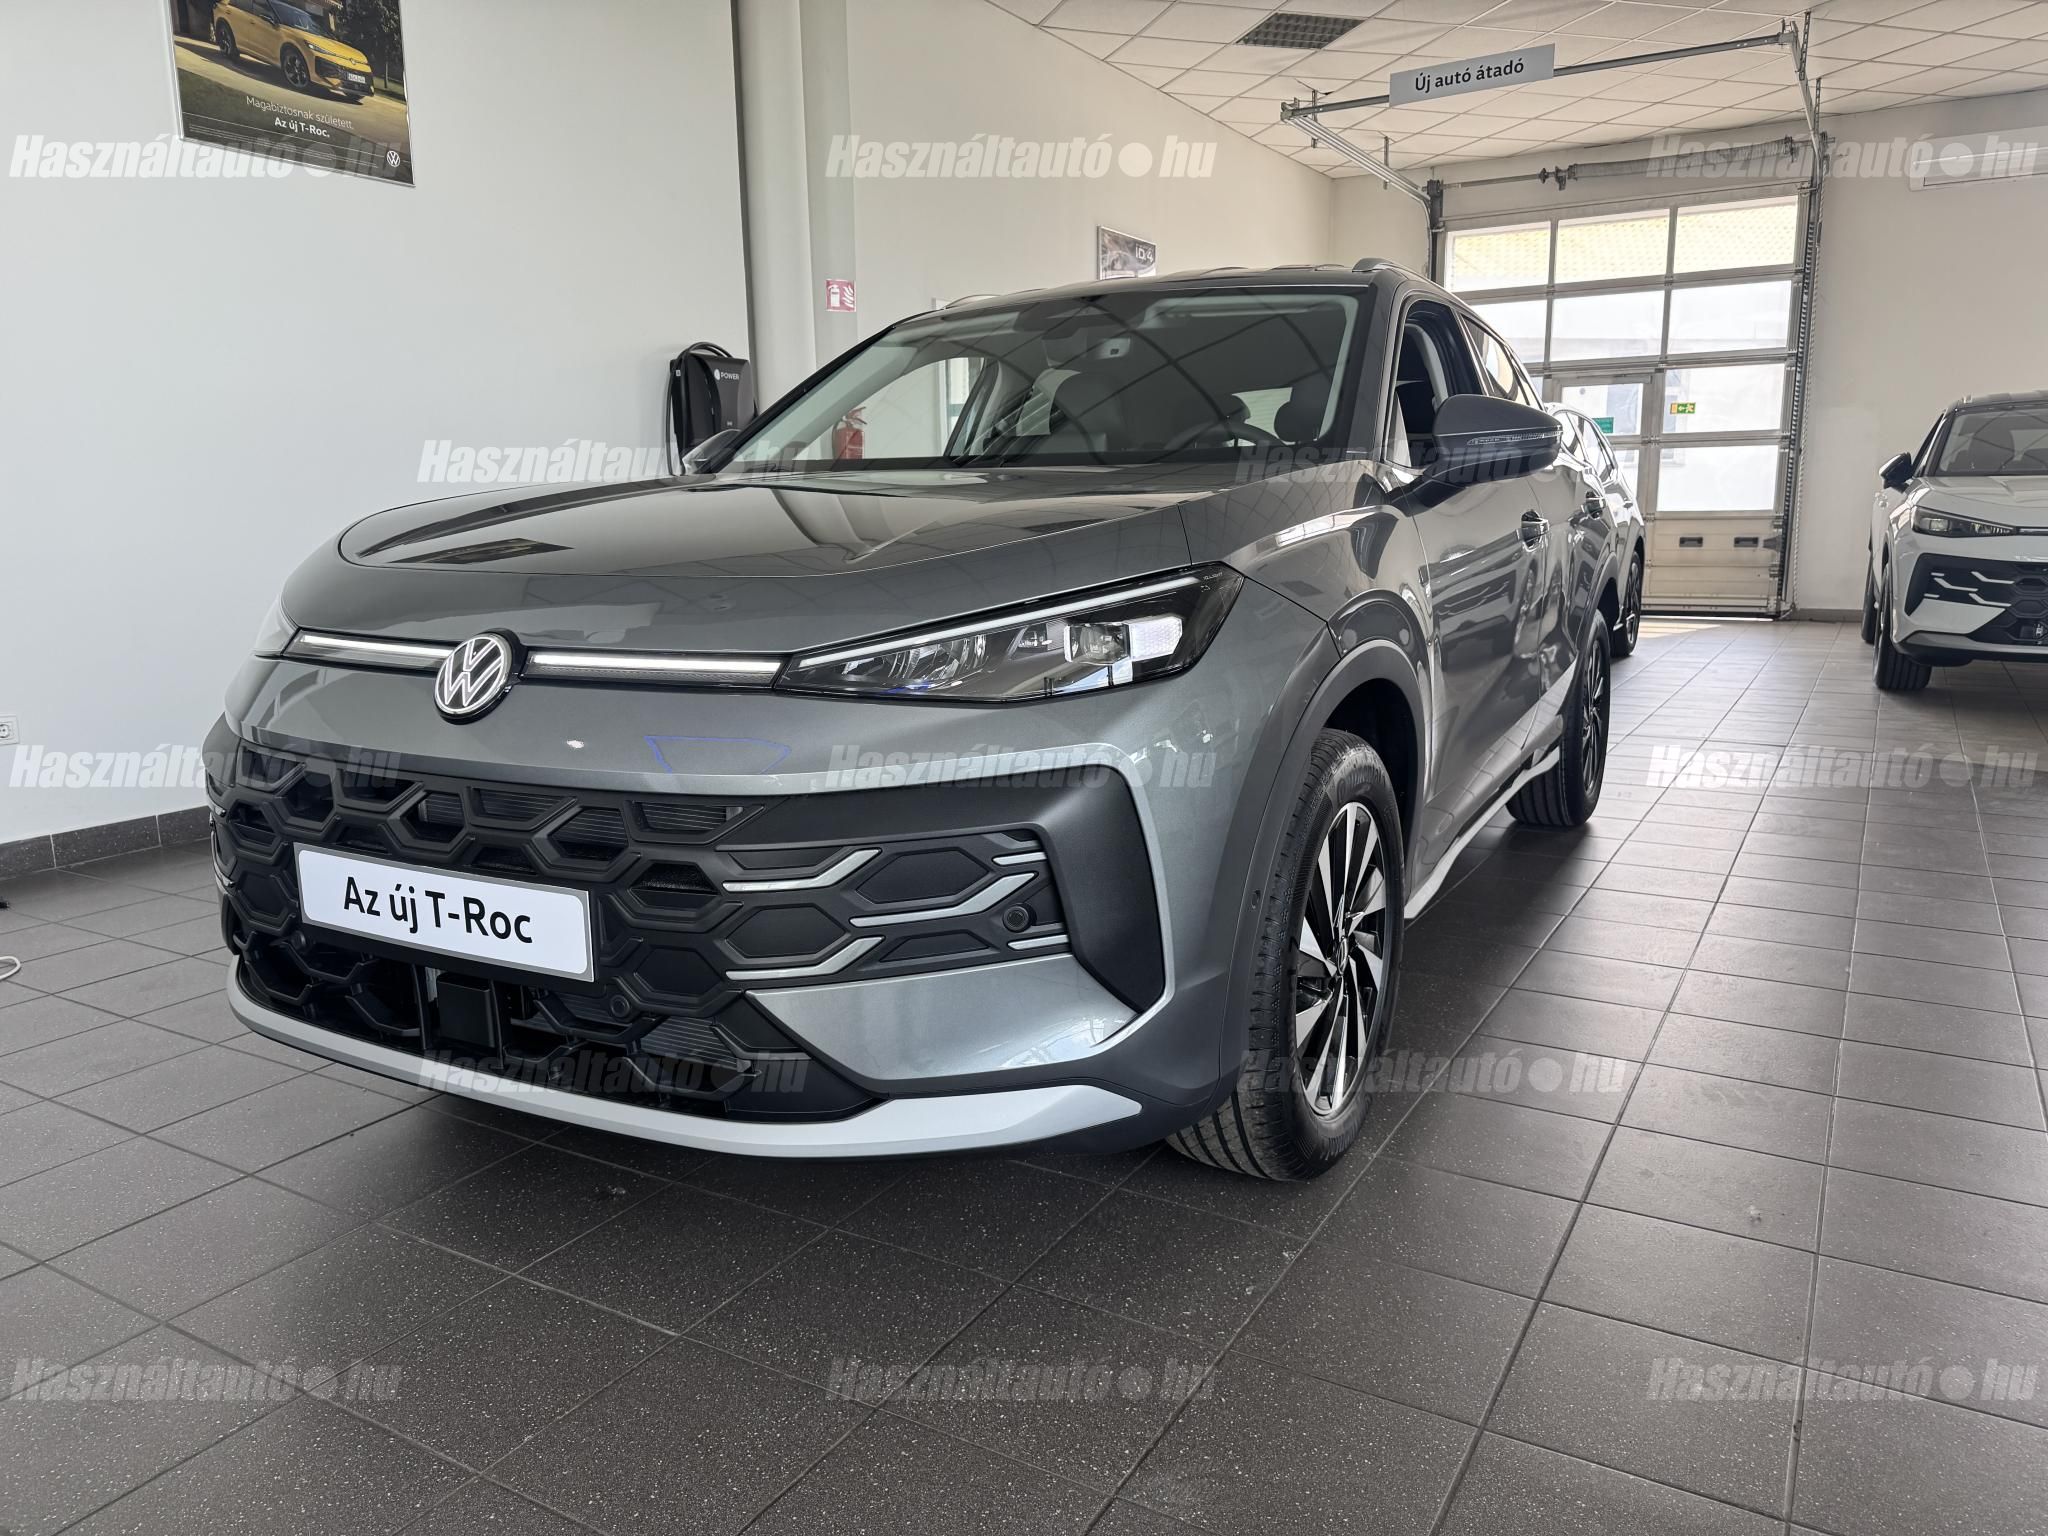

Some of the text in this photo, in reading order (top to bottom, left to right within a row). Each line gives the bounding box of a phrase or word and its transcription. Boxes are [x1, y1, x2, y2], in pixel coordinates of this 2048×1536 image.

[1415, 57, 1525, 93] Új autó átadó
[245, 96, 314, 121] Magabiztosnak
[274, 116, 331, 138] Az új T-Roc.
[343, 876, 533, 944] Az új T-Roc
